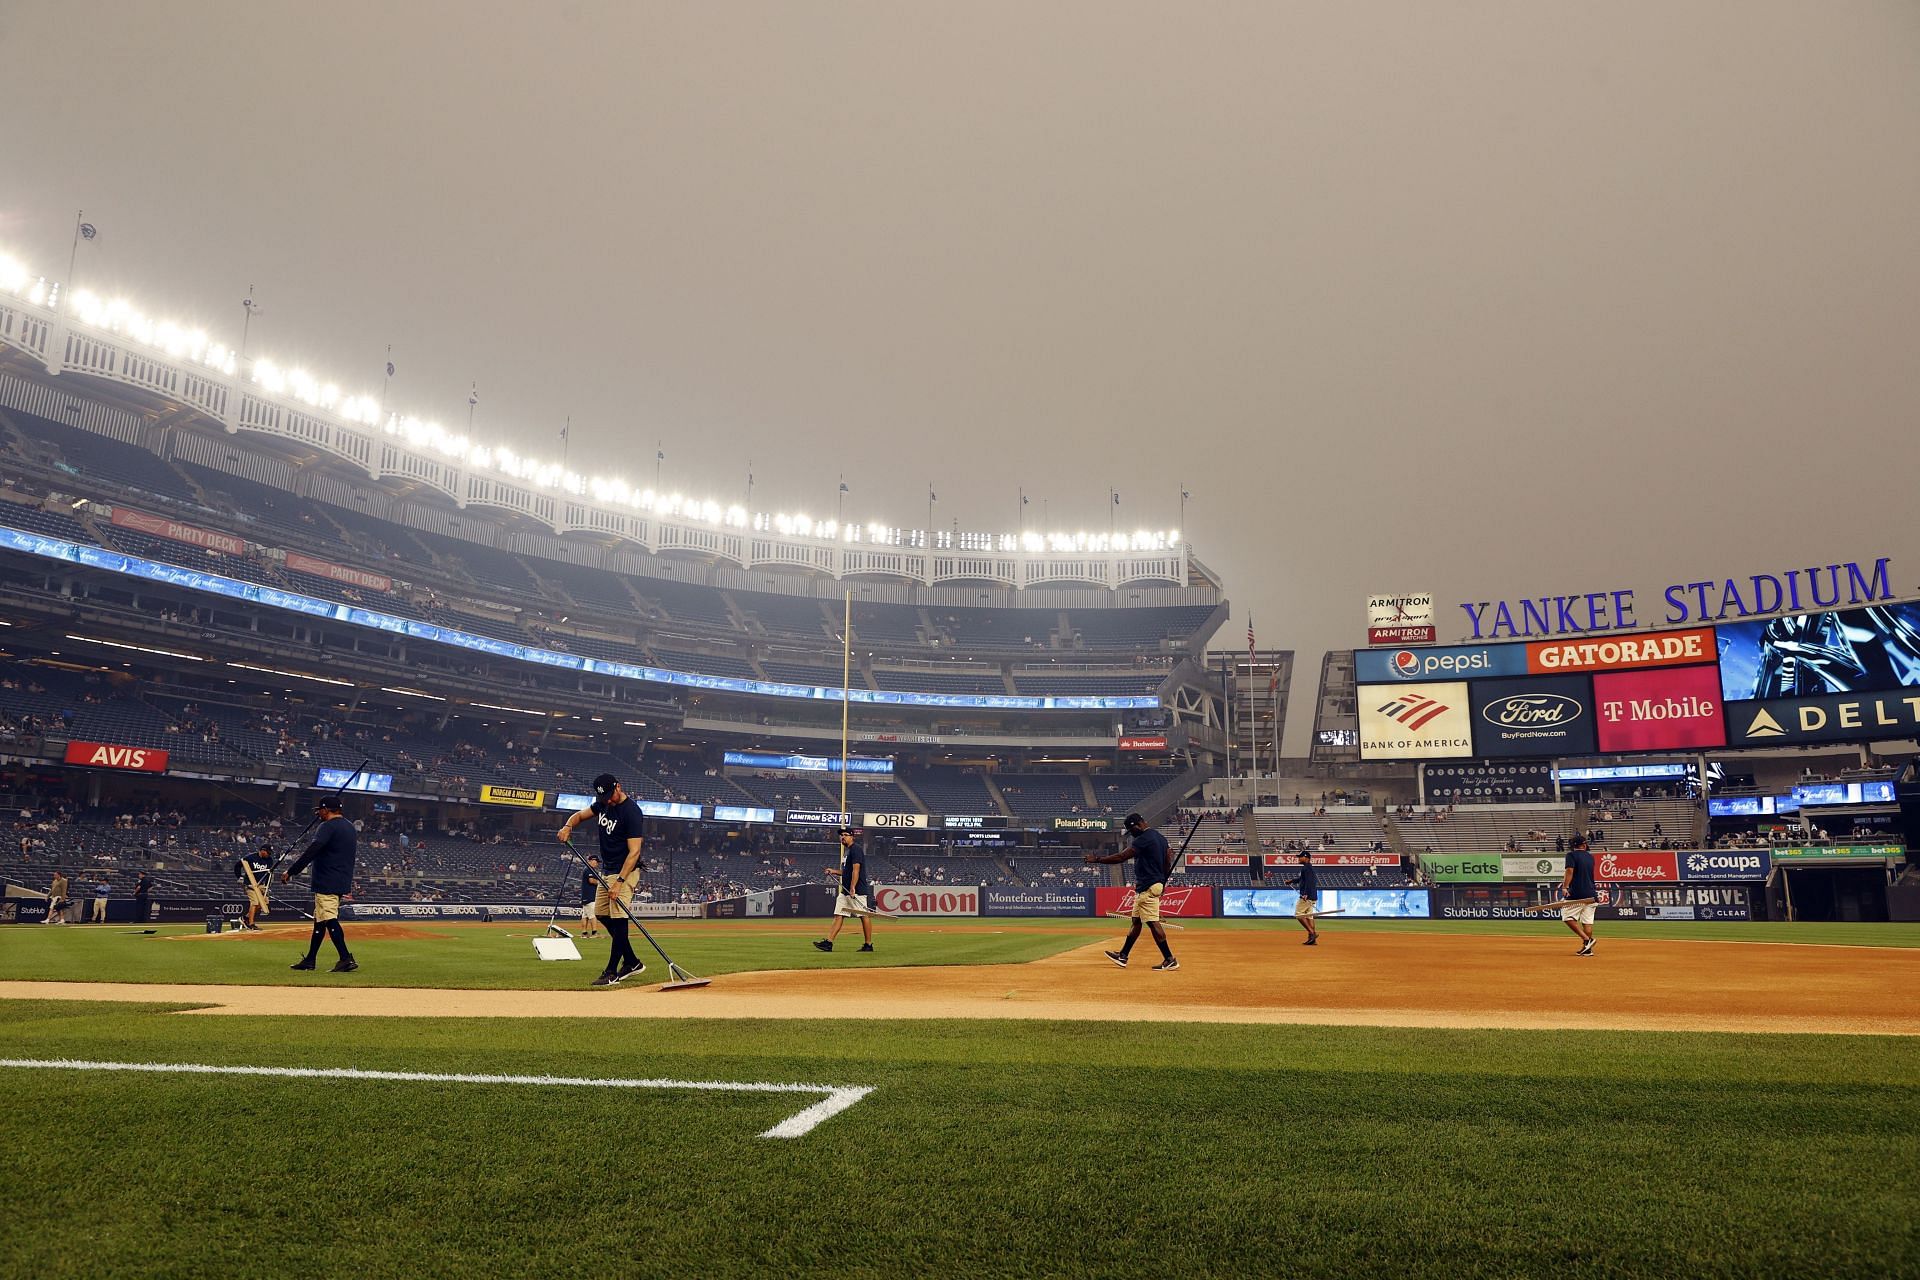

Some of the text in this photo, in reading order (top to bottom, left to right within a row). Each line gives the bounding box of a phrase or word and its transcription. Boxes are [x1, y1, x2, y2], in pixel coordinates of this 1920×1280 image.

[168, 523, 236, 553] PARTY DECK
[330, 566, 360, 584] PARTY
[361, 572, 386, 589] DECK
[1370, 597, 1430, 608] ARMITRON
[1459, 557, 1896, 640] YANKEE STADIUM
[1374, 628, 1429, 638] ARMITRON
[1538, 634, 1703, 668] GATORADE
[1424, 651, 1489, 674] pepsi
[1500, 698, 1564, 723] Ford
[1603, 697, 1714, 722] T Mobile
[1501, 729, 1567, 739] BuyFordNow.com
[1362, 738, 1469, 750] BANK OF AMERICA
[90, 746, 146, 768] AVIS
[491, 788, 512, 797] MORGAN
[516, 790, 536, 800] MORGAN
[598, 812, 618, 835] Yogi
[789, 813, 820, 821] ARMITRON
[821, 814, 837, 823] 6:24
[875, 814, 915, 827] ORIS
[1055, 818, 1107, 829] Poland Spring
[1821, 847, 1851, 855] bet365
[1203, 855, 1243, 865] StateFarm
[1350, 855, 1391, 865] StateFarm
[1709, 855, 1761, 872] coupa
[1462, 861, 1499, 874] Eats
[1600, 857, 1667, 879] Chick-fil-A
[876, 888, 977, 914] Canon
[988, 892, 1086, 903] Montefiore Einstein
[21, 906, 46, 914] StubHub
[372, 906, 396, 915] COOL
[417, 906, 439, 915] COOL
[459, 906, 480, 915] COOL
[502, 906, 523, 915] COOL
[1444, 908, 1488, 918] StubHub
[1492, 908, 1538, 918] StubHub
[1618, 908, 1633, 916] 399
